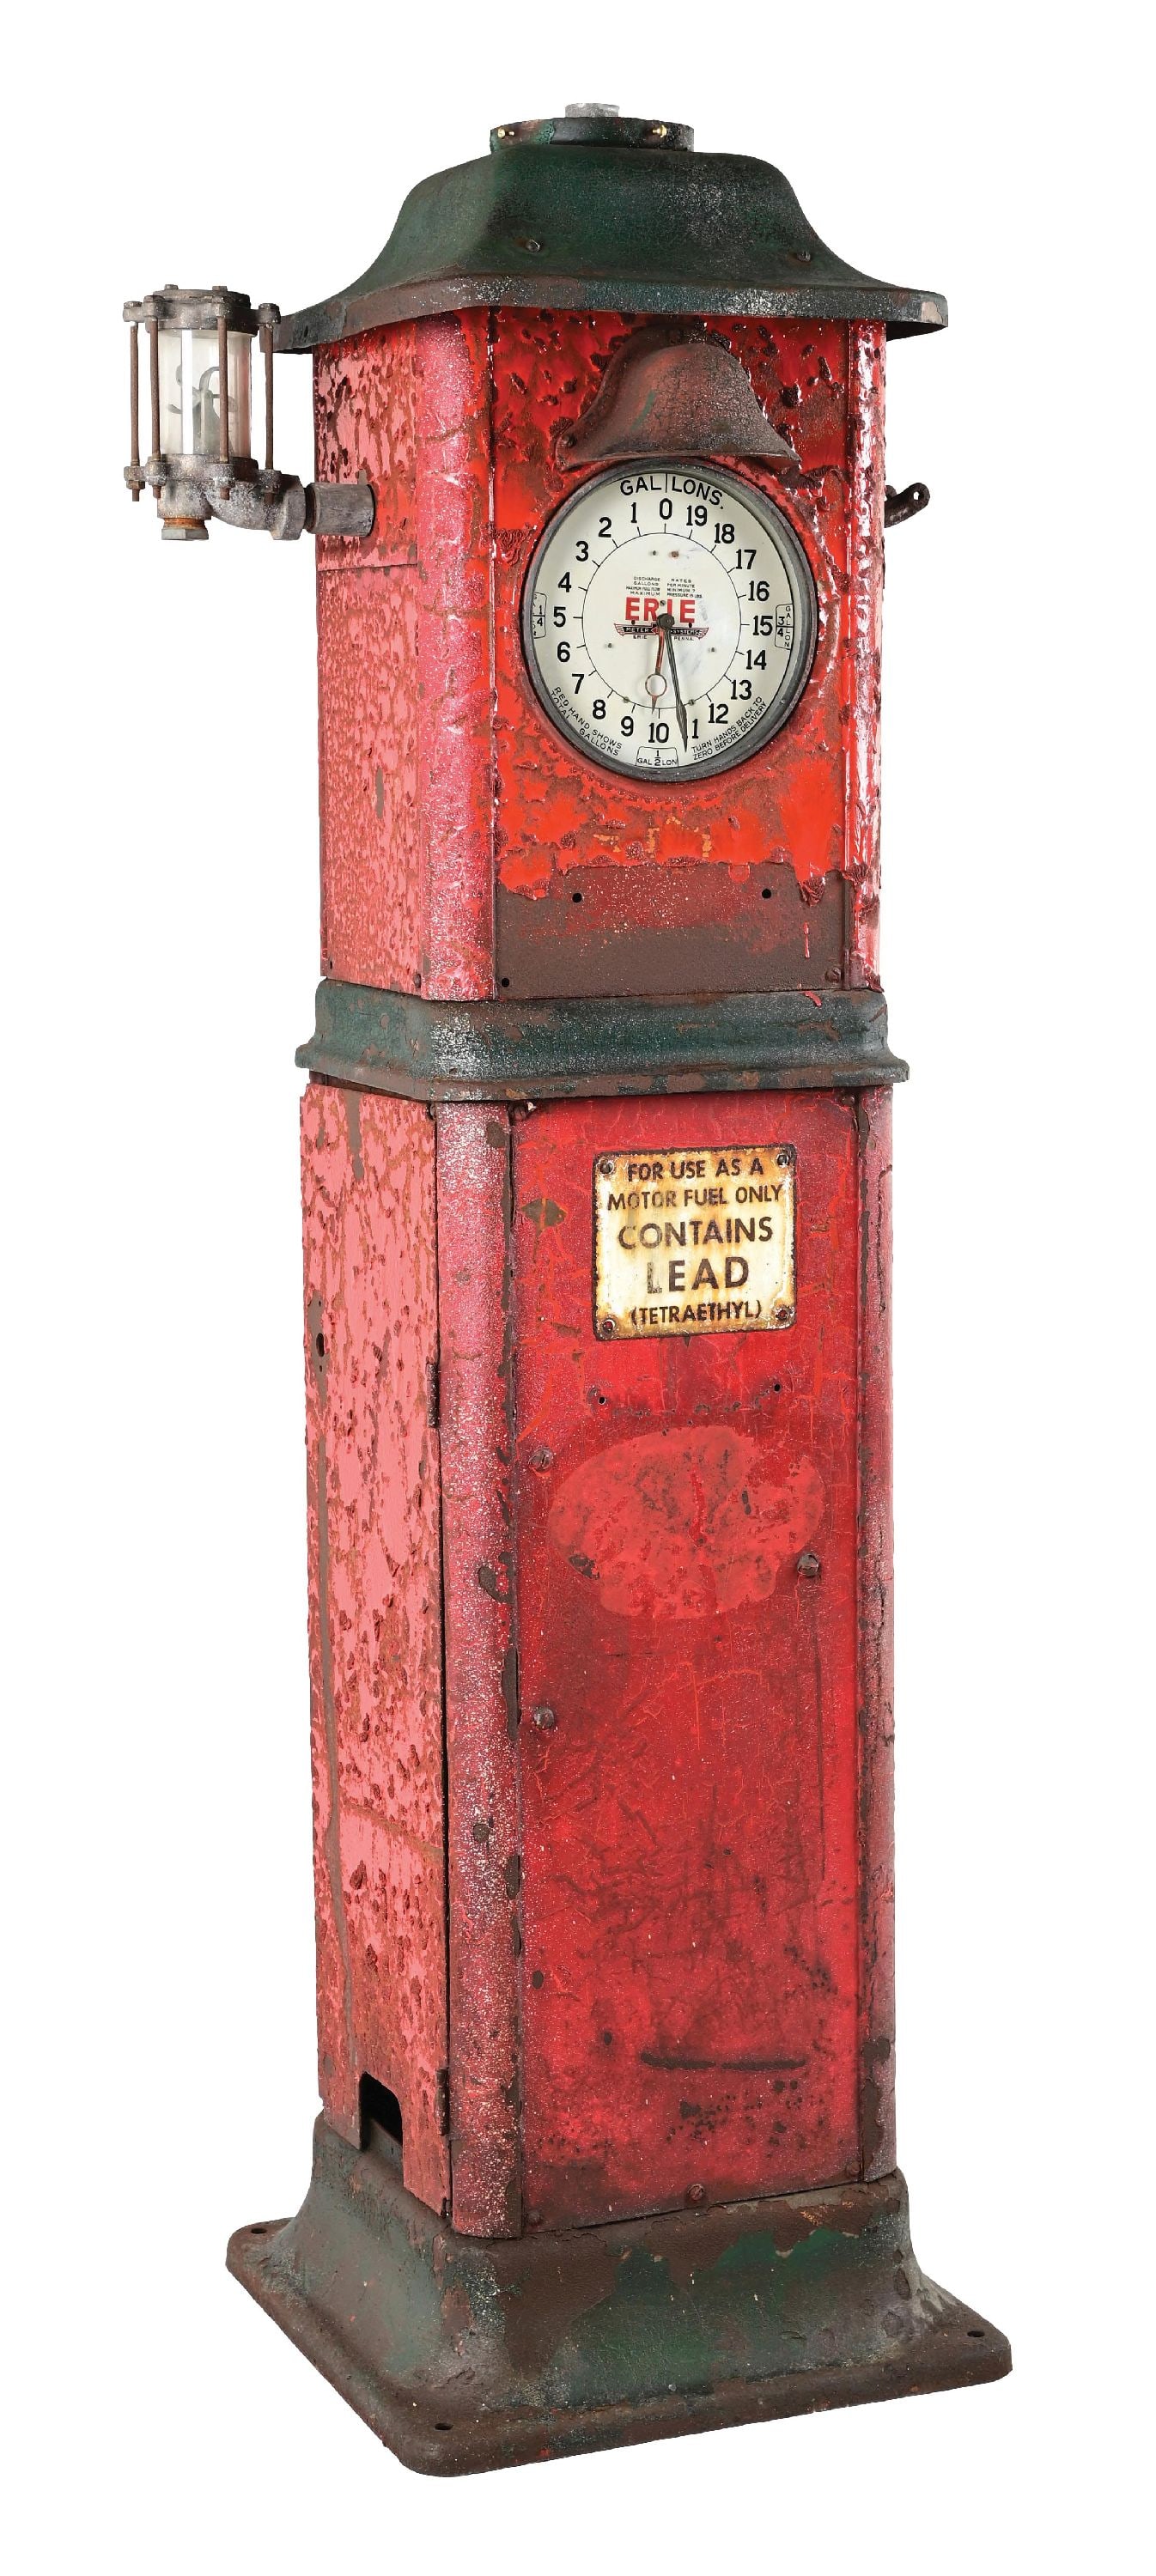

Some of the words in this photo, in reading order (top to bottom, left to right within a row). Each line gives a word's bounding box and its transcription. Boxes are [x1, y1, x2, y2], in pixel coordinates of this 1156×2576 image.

[630, 502, 637, 524] 1
[659, 498, 672, 519] 0
[686, 505, 708, 526] 19
[598, 517, 611, 538] 2
[715, 523, 735, 544] 18
[575, 541, 589, 562] 3
[735, 550, 757, 569] 17
[558, 572, 571, 592] 4
[748, 580, 770, 601] 16
[553, 606, 566, 627] 5
[625, 597, 695, 623] ERIE
[753, 616, 773, 635] 15
[557, 641, 570, 662] 6
[745, 649, 767, 670] 14
[572, 674, 584, 694] 7
[731, 679, 751, 700] 13
[554, 687, 569, 706] RED
[569, 708, 590, 729] HAND
[592, 729, 623, 749] SHOWS
[593, 699, 606, 720] 8
[708, 703, 729, 724] 12
[621, 716, 634, 737] 9
[648, 722, 669, 744] 10
[691, 740, 712, 753] TURN
[714, 725, 736, 744] HANDS
[736, 707, 755, 726] BACK
[753, 696, 763, 707] TO
[693, 748, 713, 761] ZERO
[715, 731, 741, 751] BEFORE
[740, 702, 767, 732] DELIVERY
[579, 728, 619, 756] GALLONS
[627, 1161, 664, 1182] FOR
[671, 1160, 706, 1179] USE
[715, 1158, 740, 1177] AS
[750, 1157, 764, 1176] A
[607, 1190, 677, 1211] MOTOR
[684, 1188, 728, 1206] FUEL
[735, 1184, 782, 1204] ONLY
[618, 1216, 773, 1249] CONTAINS
[647, 1256, 749, 1294] LEAD
[631, 1300, 762, 1326] (TETRAETHYL)
